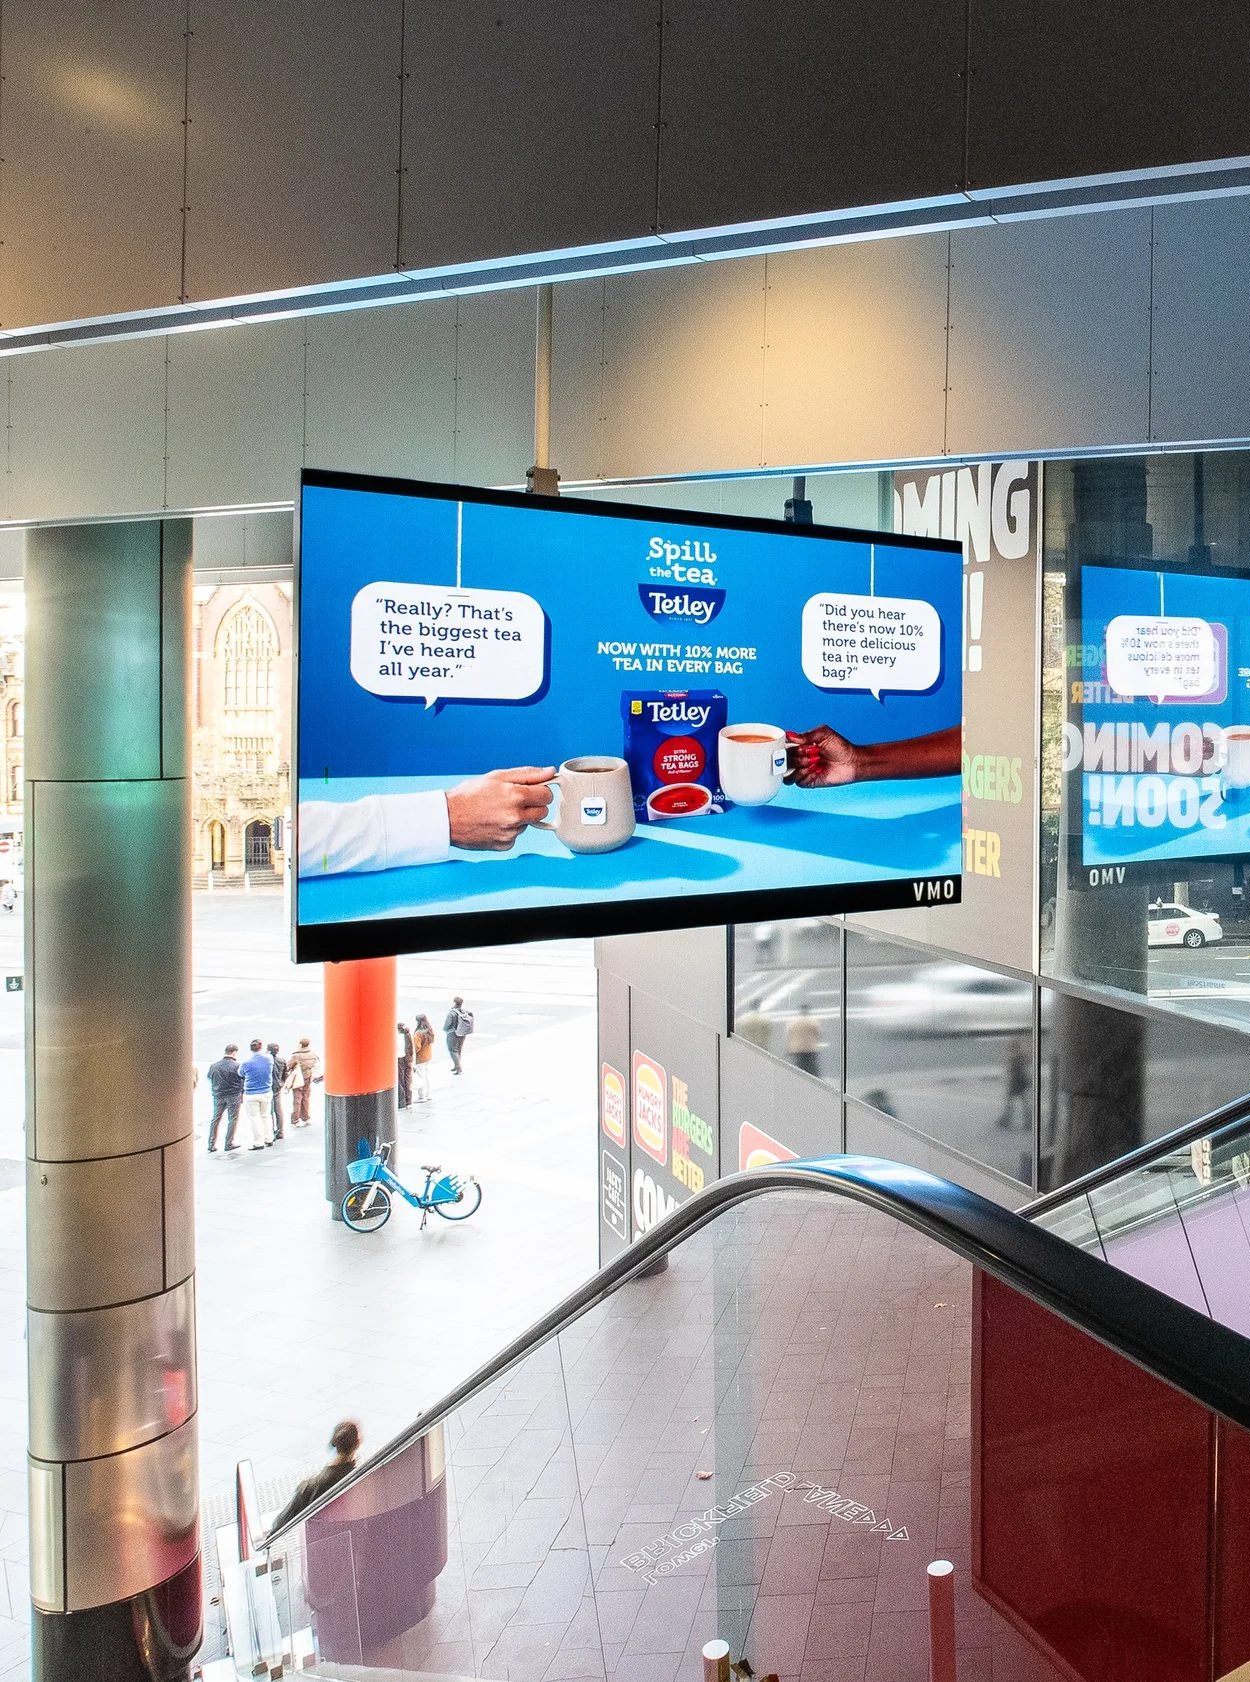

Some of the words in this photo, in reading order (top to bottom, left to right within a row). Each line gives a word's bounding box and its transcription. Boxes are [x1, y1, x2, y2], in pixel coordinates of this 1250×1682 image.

[894, 461, 1030, 560] MING
[648, 537, 717, 566] Spill
[649, 566, 671, 578] the
[671, 563, 716, 586] tea
[375, 598, 452, 619] "Really?
[457, 604, 513, 622] That's
[649, 592, 715, 624] Tetley
[819, 603, 847, 617] "Did
[850, 608, 874, 620] you
[878, 608, 906, 620] hear
[380, 621, 412, 636] the
[418, 622, 489, 641] biggest
[494, 628, 522, 642] tea
[822, 620, 865, 633] there's
[869, 625, 896, 635] now
[900, 624, 924, 637] 10%
[379, 640, 414, 656] I've
[421, 643, 476, 659] heard
[597, 641, 637, 656] NOW
[639, 643, 681, 657] WITH
[685, 645, 712, 659] 10%
[716, 646, 757, 660] MORE
[822, 637, 857, 648] more
[860, 637, 916, 651] delicious
[612, 657, 642, 671] TEA
[646, 659, 663, 672] IN
[667, 660, 711, 674] EVERY
[714, 661, 743, 674] BAG
[822, 651, 842, 662] tea
[846, 651, 858, 663] in
[862, 655, 897, 668] every
[379, 662, 402, 676] all
[408, 664, 462, 680] year."
[822, 666, 858, 681] bag?"
[647, 701, 711, 728] Tetley
[663, 754, 696, 762] STRONG
[913, 879, 954, 901] VMO
[672, 1075, 688, 1109] THE
[673, 1101, 713, 1156] BURGERS
